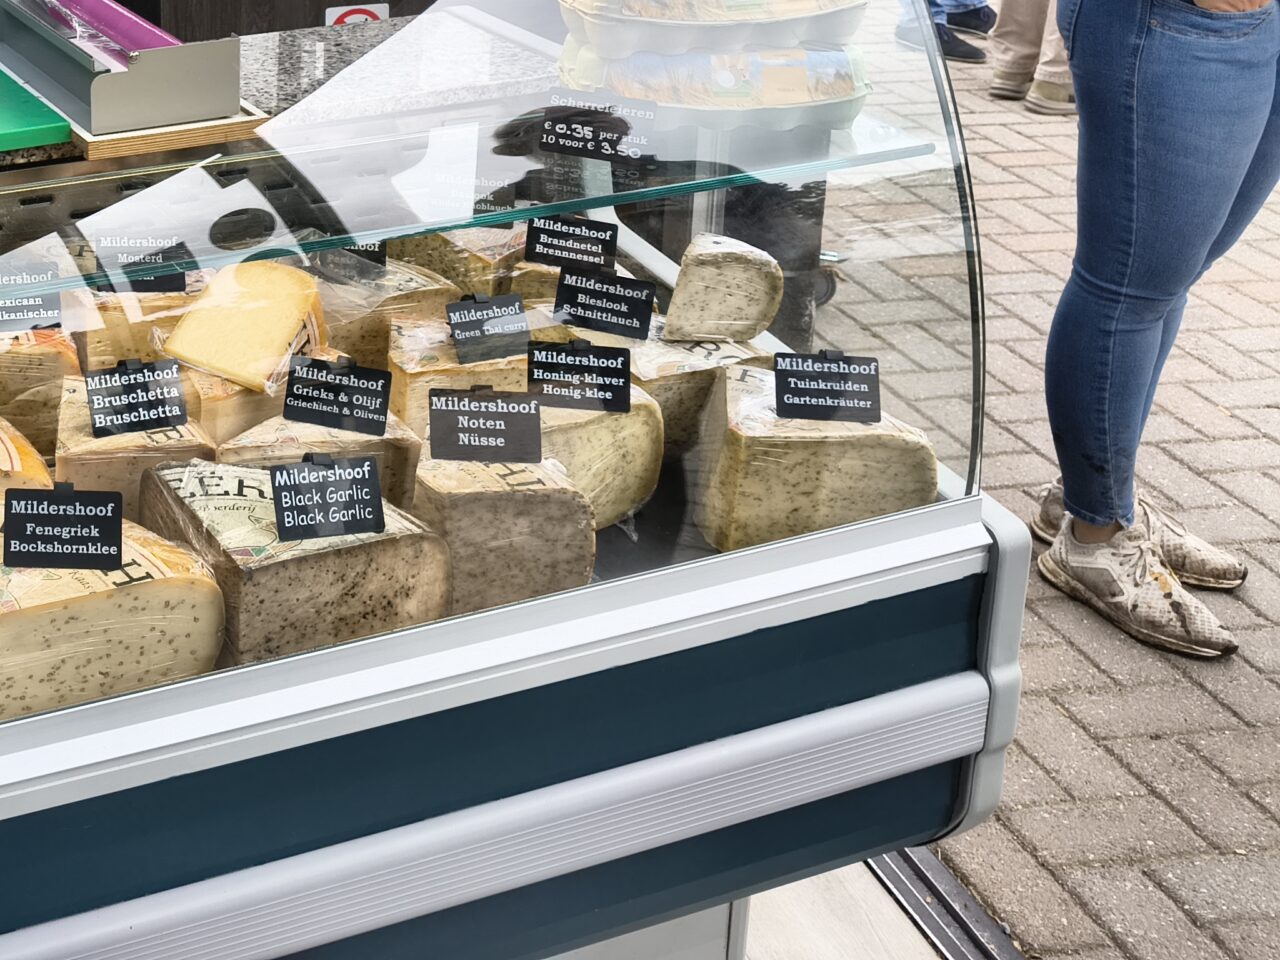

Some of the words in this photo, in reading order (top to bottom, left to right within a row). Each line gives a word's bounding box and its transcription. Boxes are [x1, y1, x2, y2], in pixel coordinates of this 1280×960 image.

[550, 94, 655, 120] Scharreleieren
[544, 121, 553, 130] €
[555, 122, 594, 141] 0.35
[599, 129, 619, 141] per
[541, 134, 556, 144] 10
[558, 137, 585, 149] voor
[587, 141, 595, 151] €
[600, 142, 641, 160] 3.50
[532, 218, 613, 241] Mildershoof
[99, 235, 179, 248] Mildershoof
[539, 234, 603, 254] Brandnetel
[117, 252, 163, 263] Mosterd
[535, 244, 605, 265] Brennnessel
[563, 274, 649, 301] Mildershoof
[449, 302, 521, 324] Mildershoof
[576, 293, 630, 313] Bieslook
[562, 304, 641, 329] Schnittlauch
[454, 329, 481, 340] Green
[483, 325, 502, 335] Thai
[503, 322, 527, 332] curry
[532, 349, 625, 369] Mildershoof
[775, 358, 878, 375] Mildershoof
[85, 364, 179, 390] Mildershoof
[293, 365, 385, 392] Mildershoof
[532, 368, 625, 387] Honing-klaver
[787, 377, 869, 392] Tuinkruiden
[91, 385, 180, 409] Bruschetta
[293, 384, 335, 400] Grieks
[338, 392, 349, 403] &
[352, 394, 383, 410] Olijf
[542, 384, 613, 400] Honig-klee
[783, 394, 872, 409] Gartenkräuter
[286, 397, 340, 414] Griechisch
[342, 406, 351, 416] &
[353, 408, 386, 422] Oliven
[431, 396, 538, 414] Mildershoof
[93, 404, 182, 428] Bruschetta
[457, 415, 506, 430] Noten
[457, 432, 506, 447] Nüsse
[274, 461, 371, 487] Mildershoof
[281, 489, 323, 508] Black
[326, 484, 371, 504] Garlic
[10, 500, 115, 517] Mildershoof
[283, 508, 325, 527] Black
[328, 503, 373, 523] Garlic
[25, 523, 100, 540] Fenegriek
[9, 540, 118, 555] Bockshornklee
